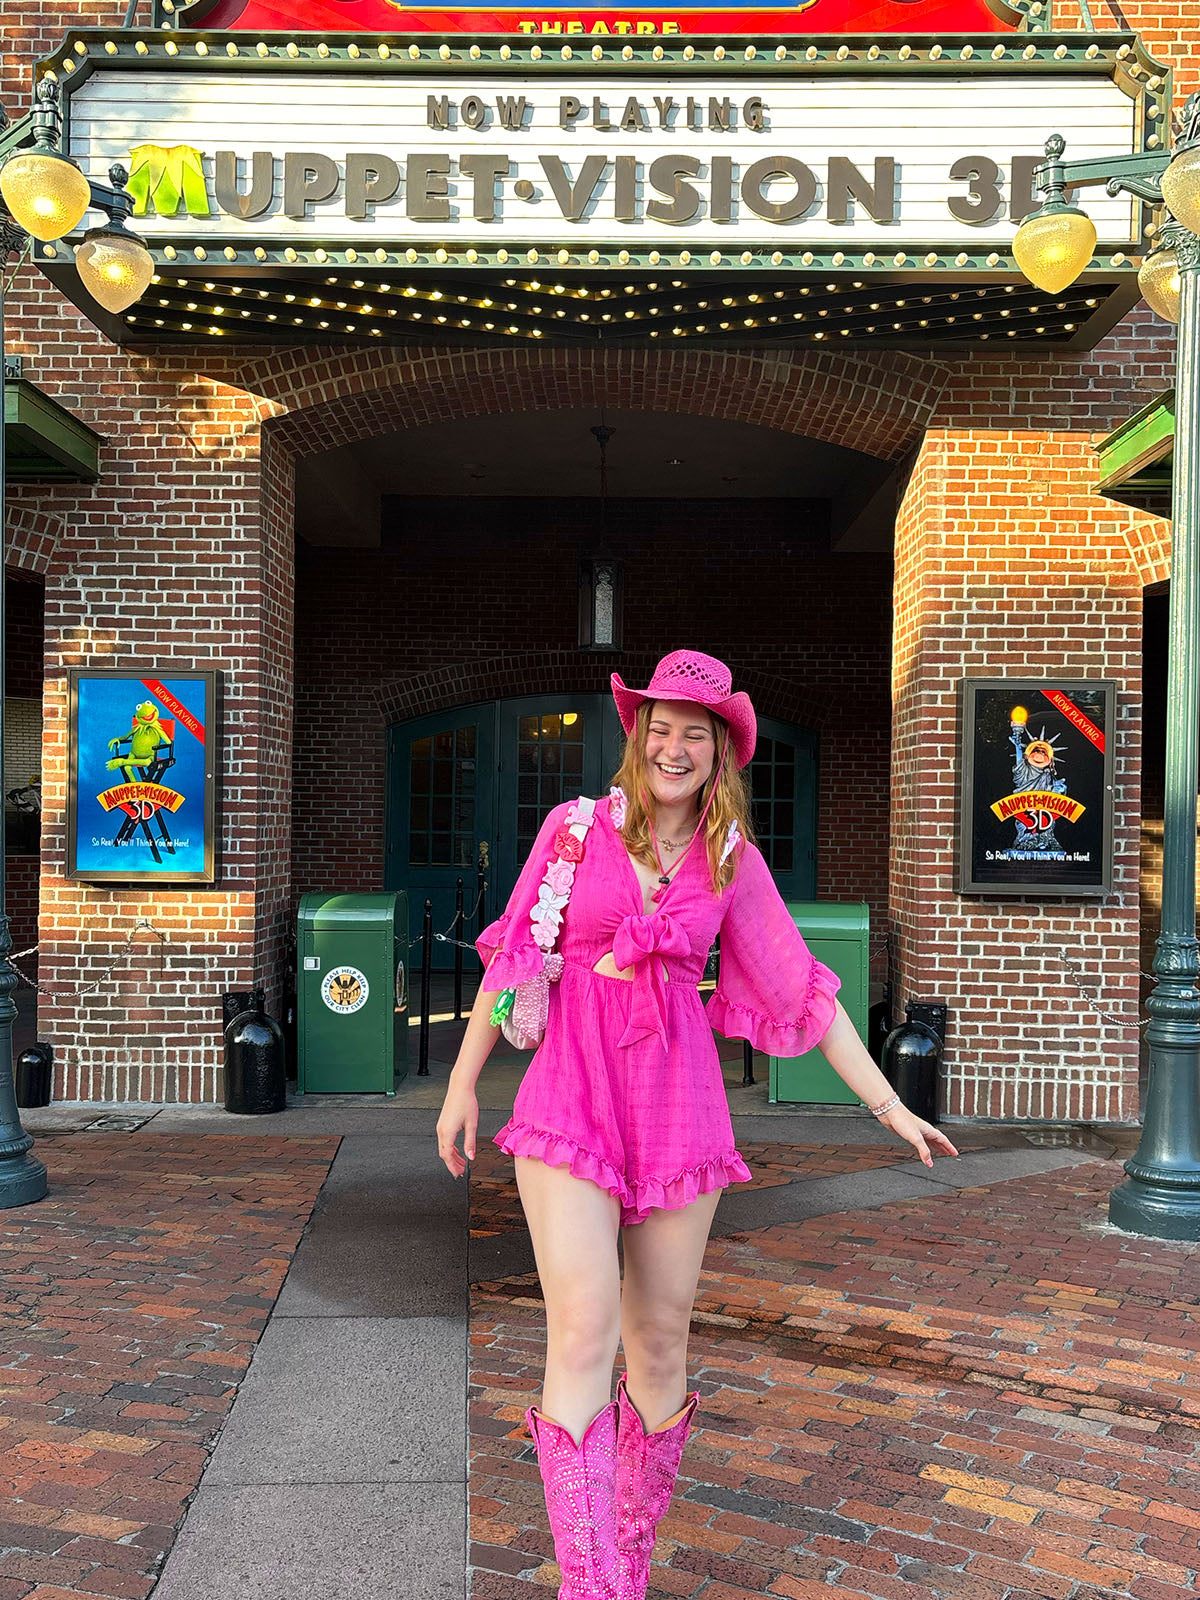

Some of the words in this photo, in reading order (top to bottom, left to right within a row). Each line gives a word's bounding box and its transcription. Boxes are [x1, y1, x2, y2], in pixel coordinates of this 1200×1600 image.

[518, 21, 681, 34] THEATRE
[427, 95, 528, 130] NOW
[560, 96, 768, 132] PLAYING
[154, 686, 172, 703] NOW
[169, 701, 198, 731] PLAYING
[1053, 694, 1072, 712] NOW
[1069, 710, 1100, 741] PLAYING
[130, 799, 155, 820] 3D
[1026, 808, 1053, 830] 3D
[92, 837, 99, 846] So
[135, 838, 153, 847] Think
[985, 850, 994, 860] So
[1033, 851, 1051, 860] Think
[324, 970, 339, 988] PLEASE
[357, 973, 367, 988] KEEP
[324, 994, 335, 1007] OUR
[351, 995, 366, 1010] CLEAN
